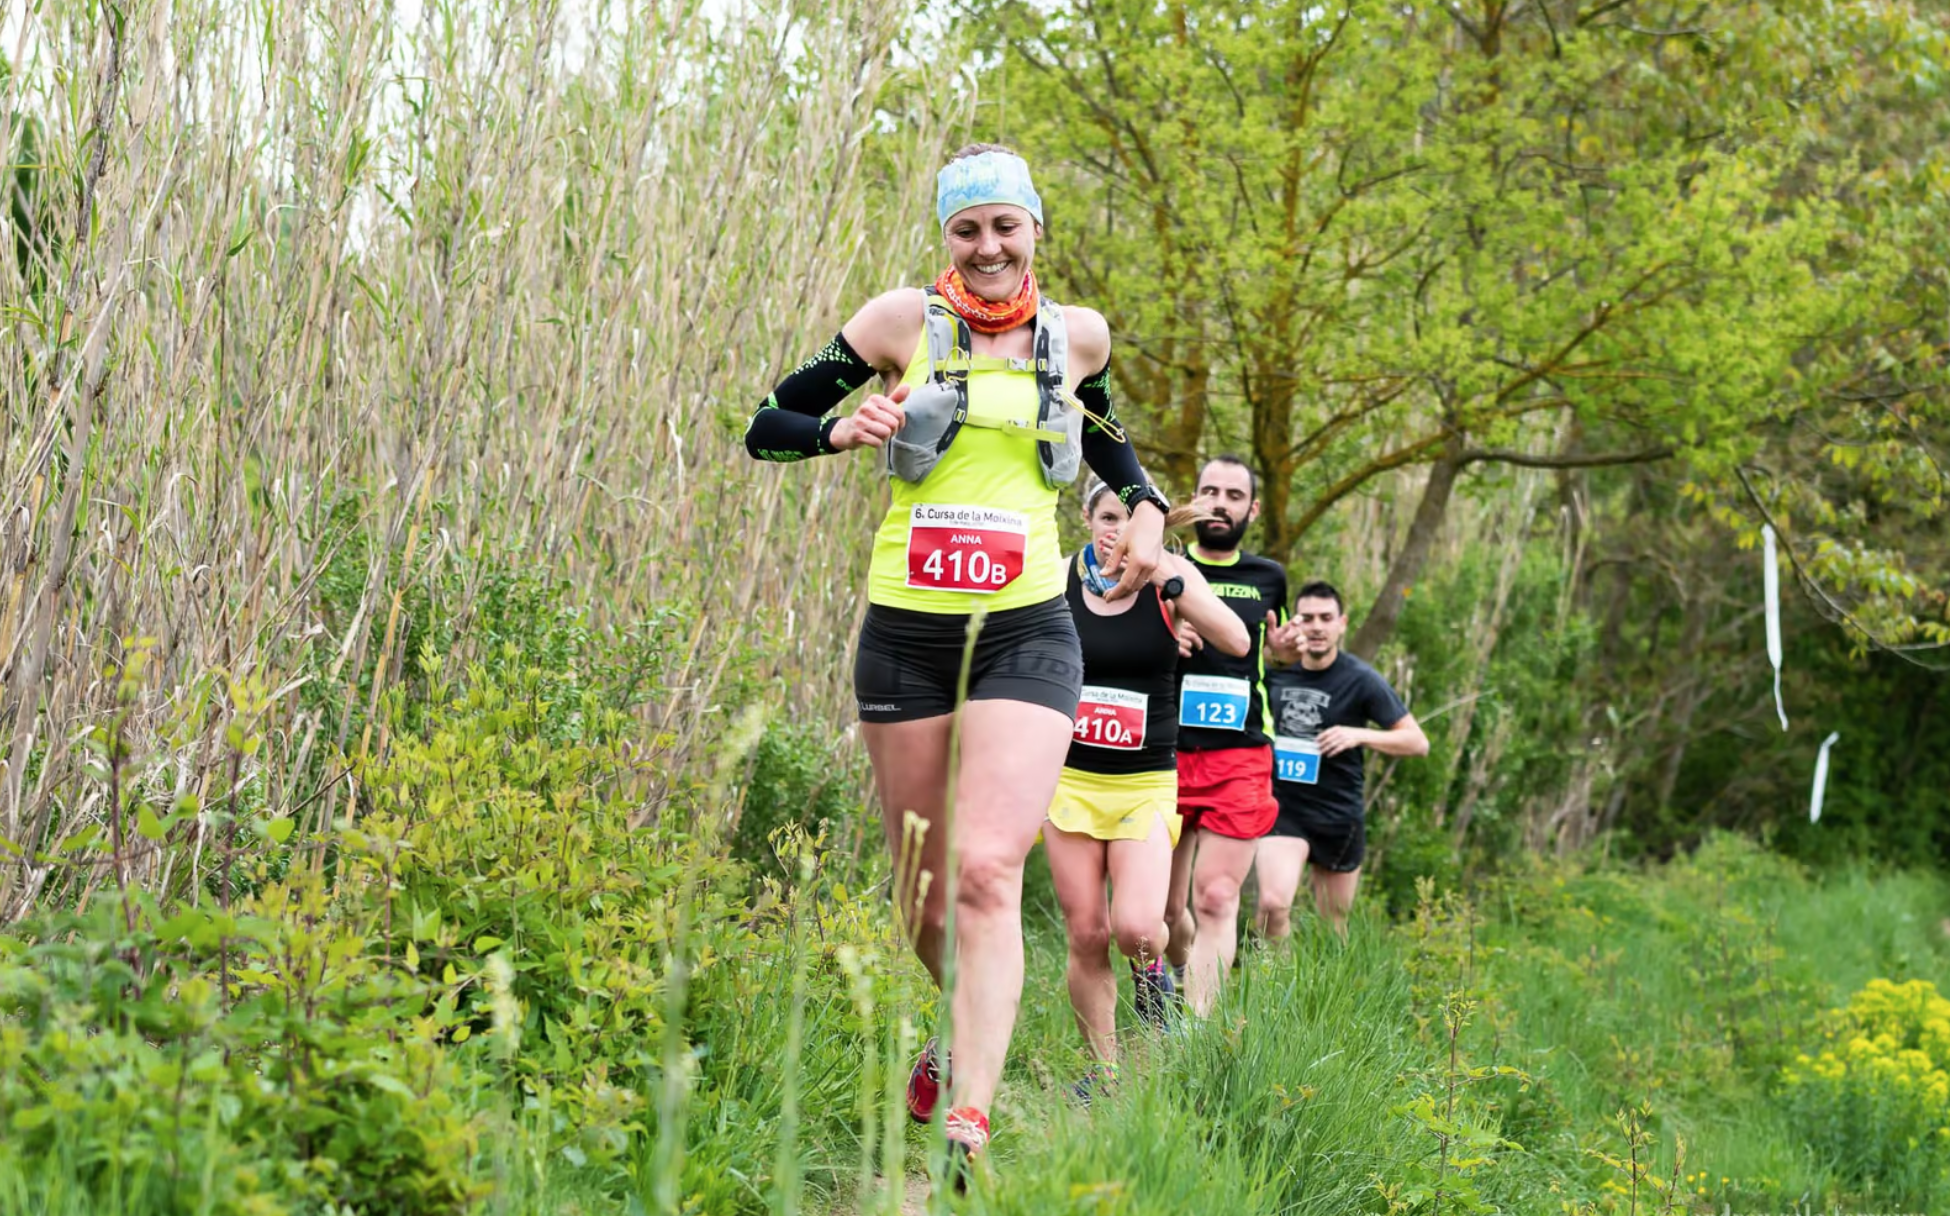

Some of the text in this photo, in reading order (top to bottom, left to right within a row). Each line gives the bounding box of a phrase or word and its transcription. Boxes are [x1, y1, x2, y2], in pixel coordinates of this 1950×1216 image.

[915, 508, 925, 519] 6.
[927, 508, 955, 520] Cursa
[957, 510, 970, 520] de
[972, 511, 981, 521] la
[950, 534, 982, 545] ANNA
[922, 549, 1007, 585] 410B
[1094, 706, 1117, 717] ANNA
[1196, 702, 1237, 724] 123
[1074, 716, 1133, 744] 410A
[1278, 758, 1307, 777] 119
